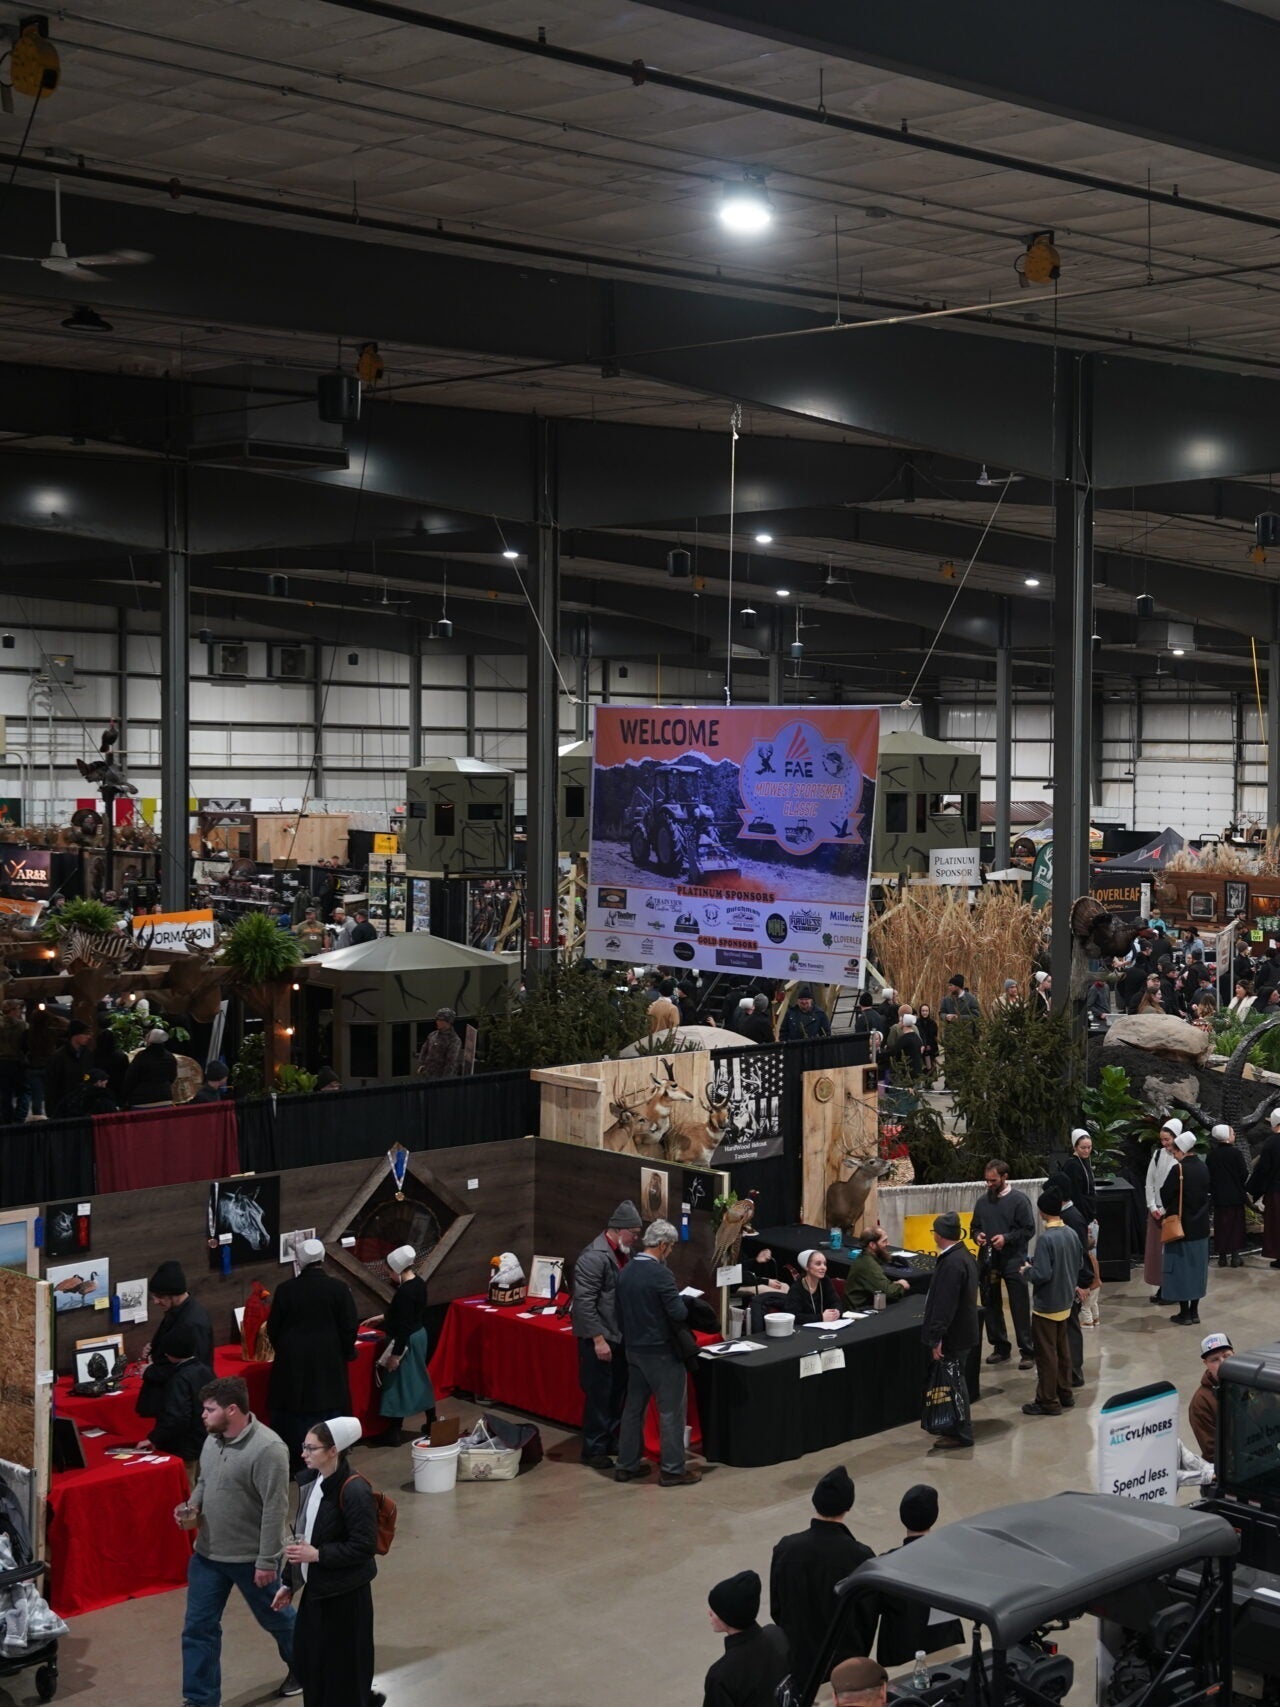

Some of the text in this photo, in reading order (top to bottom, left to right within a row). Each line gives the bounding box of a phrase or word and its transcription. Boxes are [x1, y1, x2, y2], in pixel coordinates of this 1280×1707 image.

[620, 718, 720, 746] WELCOME
[784, 761, 814, 778] FAE
[755, 782, 845, 799] MIDWEST SPORTSMEN
[934, 856, 975, 866] PLATINUM
[936, 868, 973, 878] SPONSOR
[677, 886, 775, 902] PLATINUM SPONSORS
[698, 936, 758, 950] GOLD SPONSORS
[1113, 1468, 1169, 1495] Spend less.
[1140, 1486, 1168, 1501] more.
